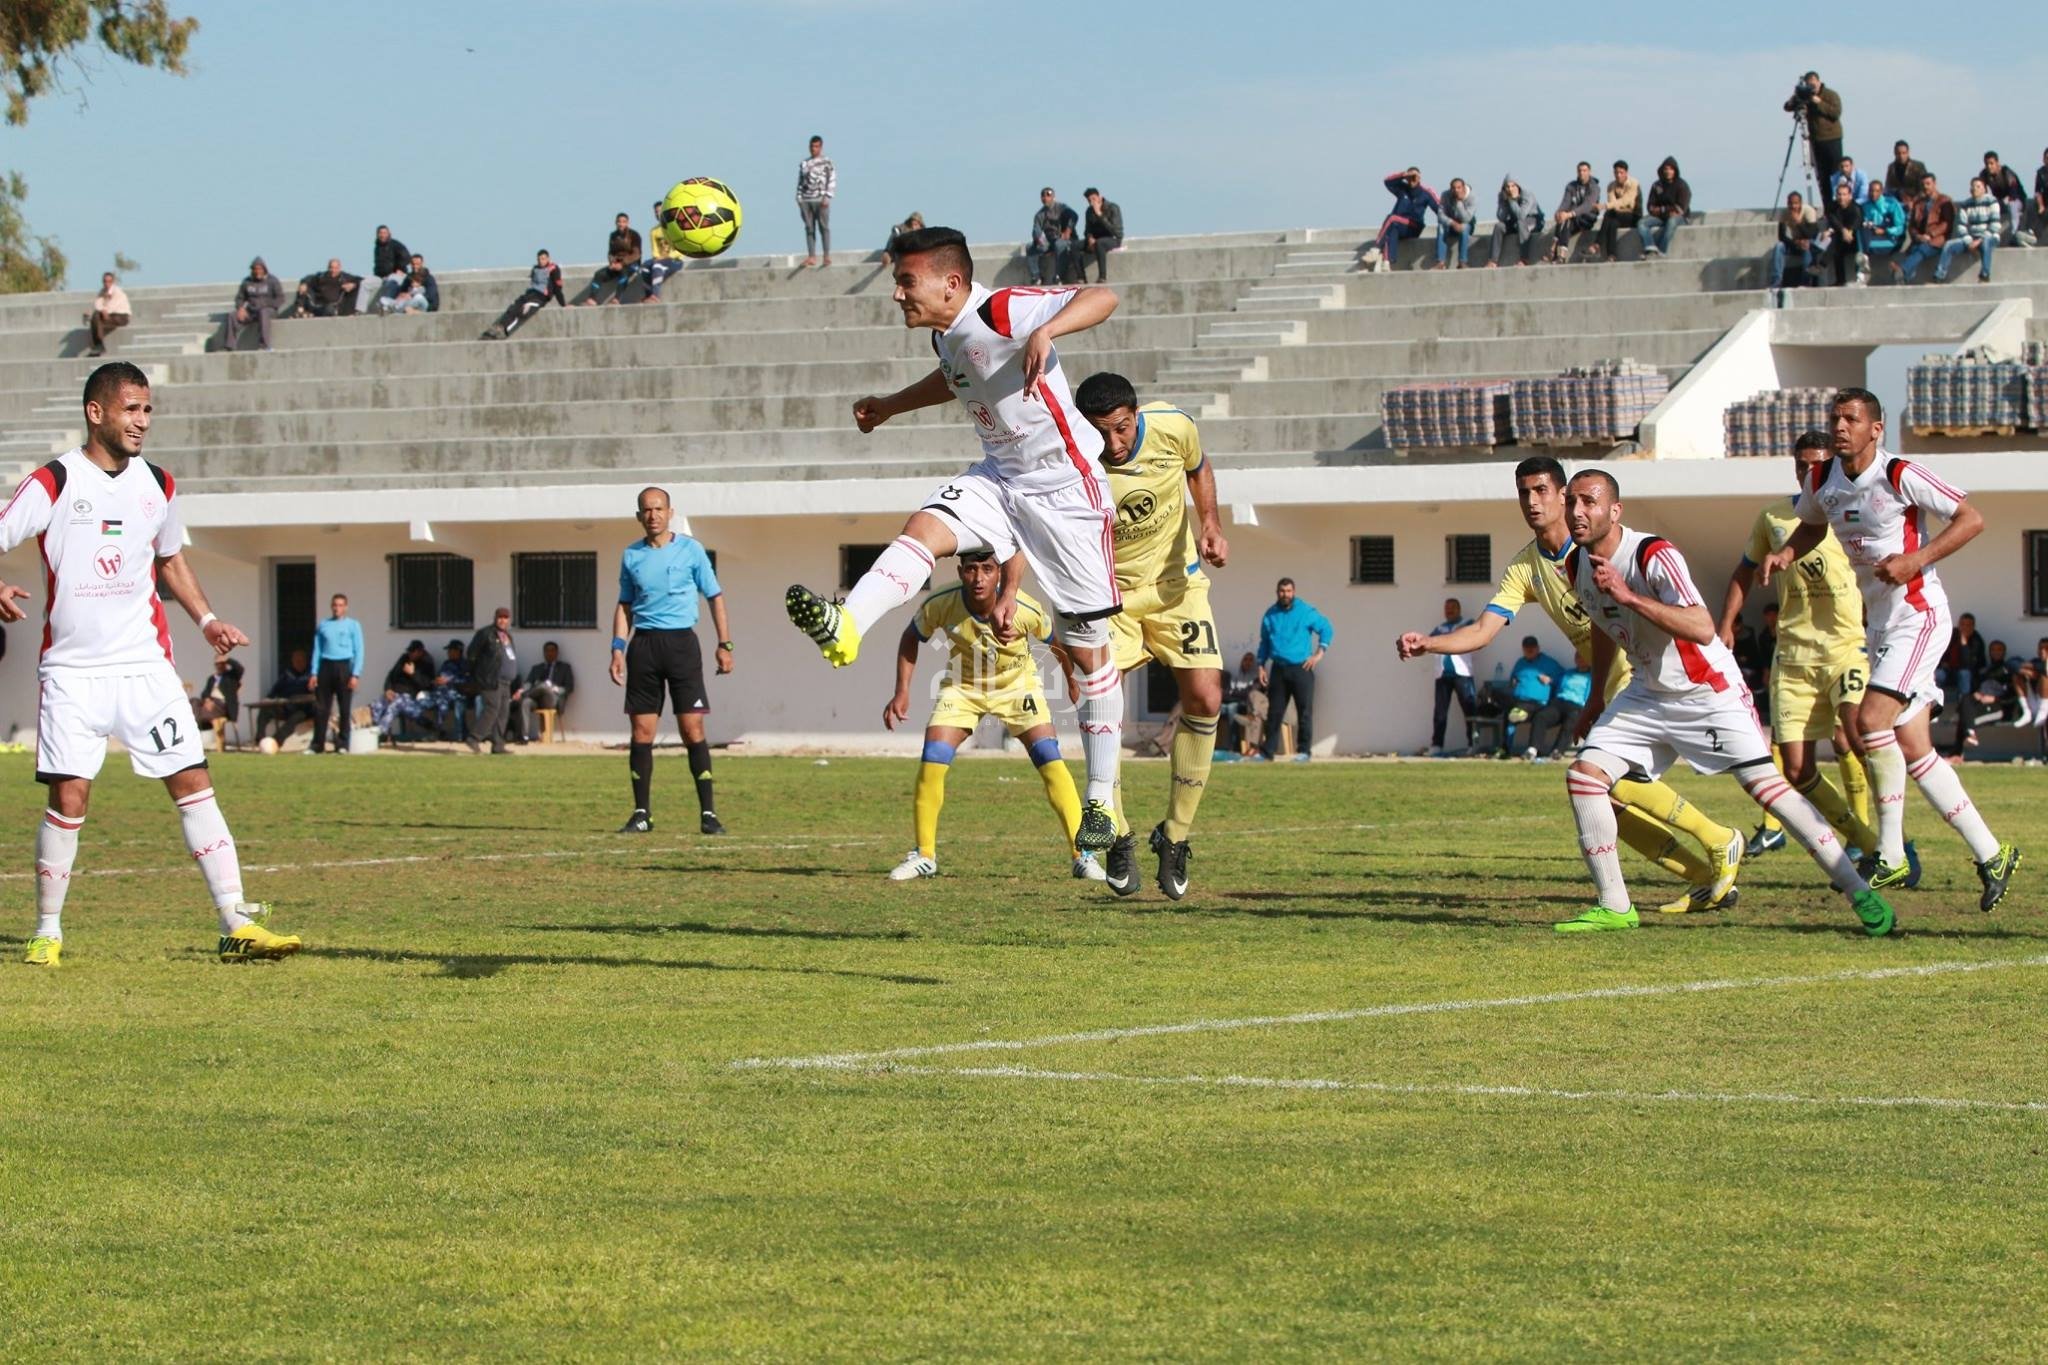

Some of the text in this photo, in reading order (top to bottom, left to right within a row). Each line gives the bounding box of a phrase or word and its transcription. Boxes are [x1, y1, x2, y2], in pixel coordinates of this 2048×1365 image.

[1181, 620, 1218, 655] 21
[1839, 669, 1864, 697] 15
[1022, 692, 1038, 715] 4
[149, 717, 184, 752] 12
[1705, 728, 1723, 751] 2
